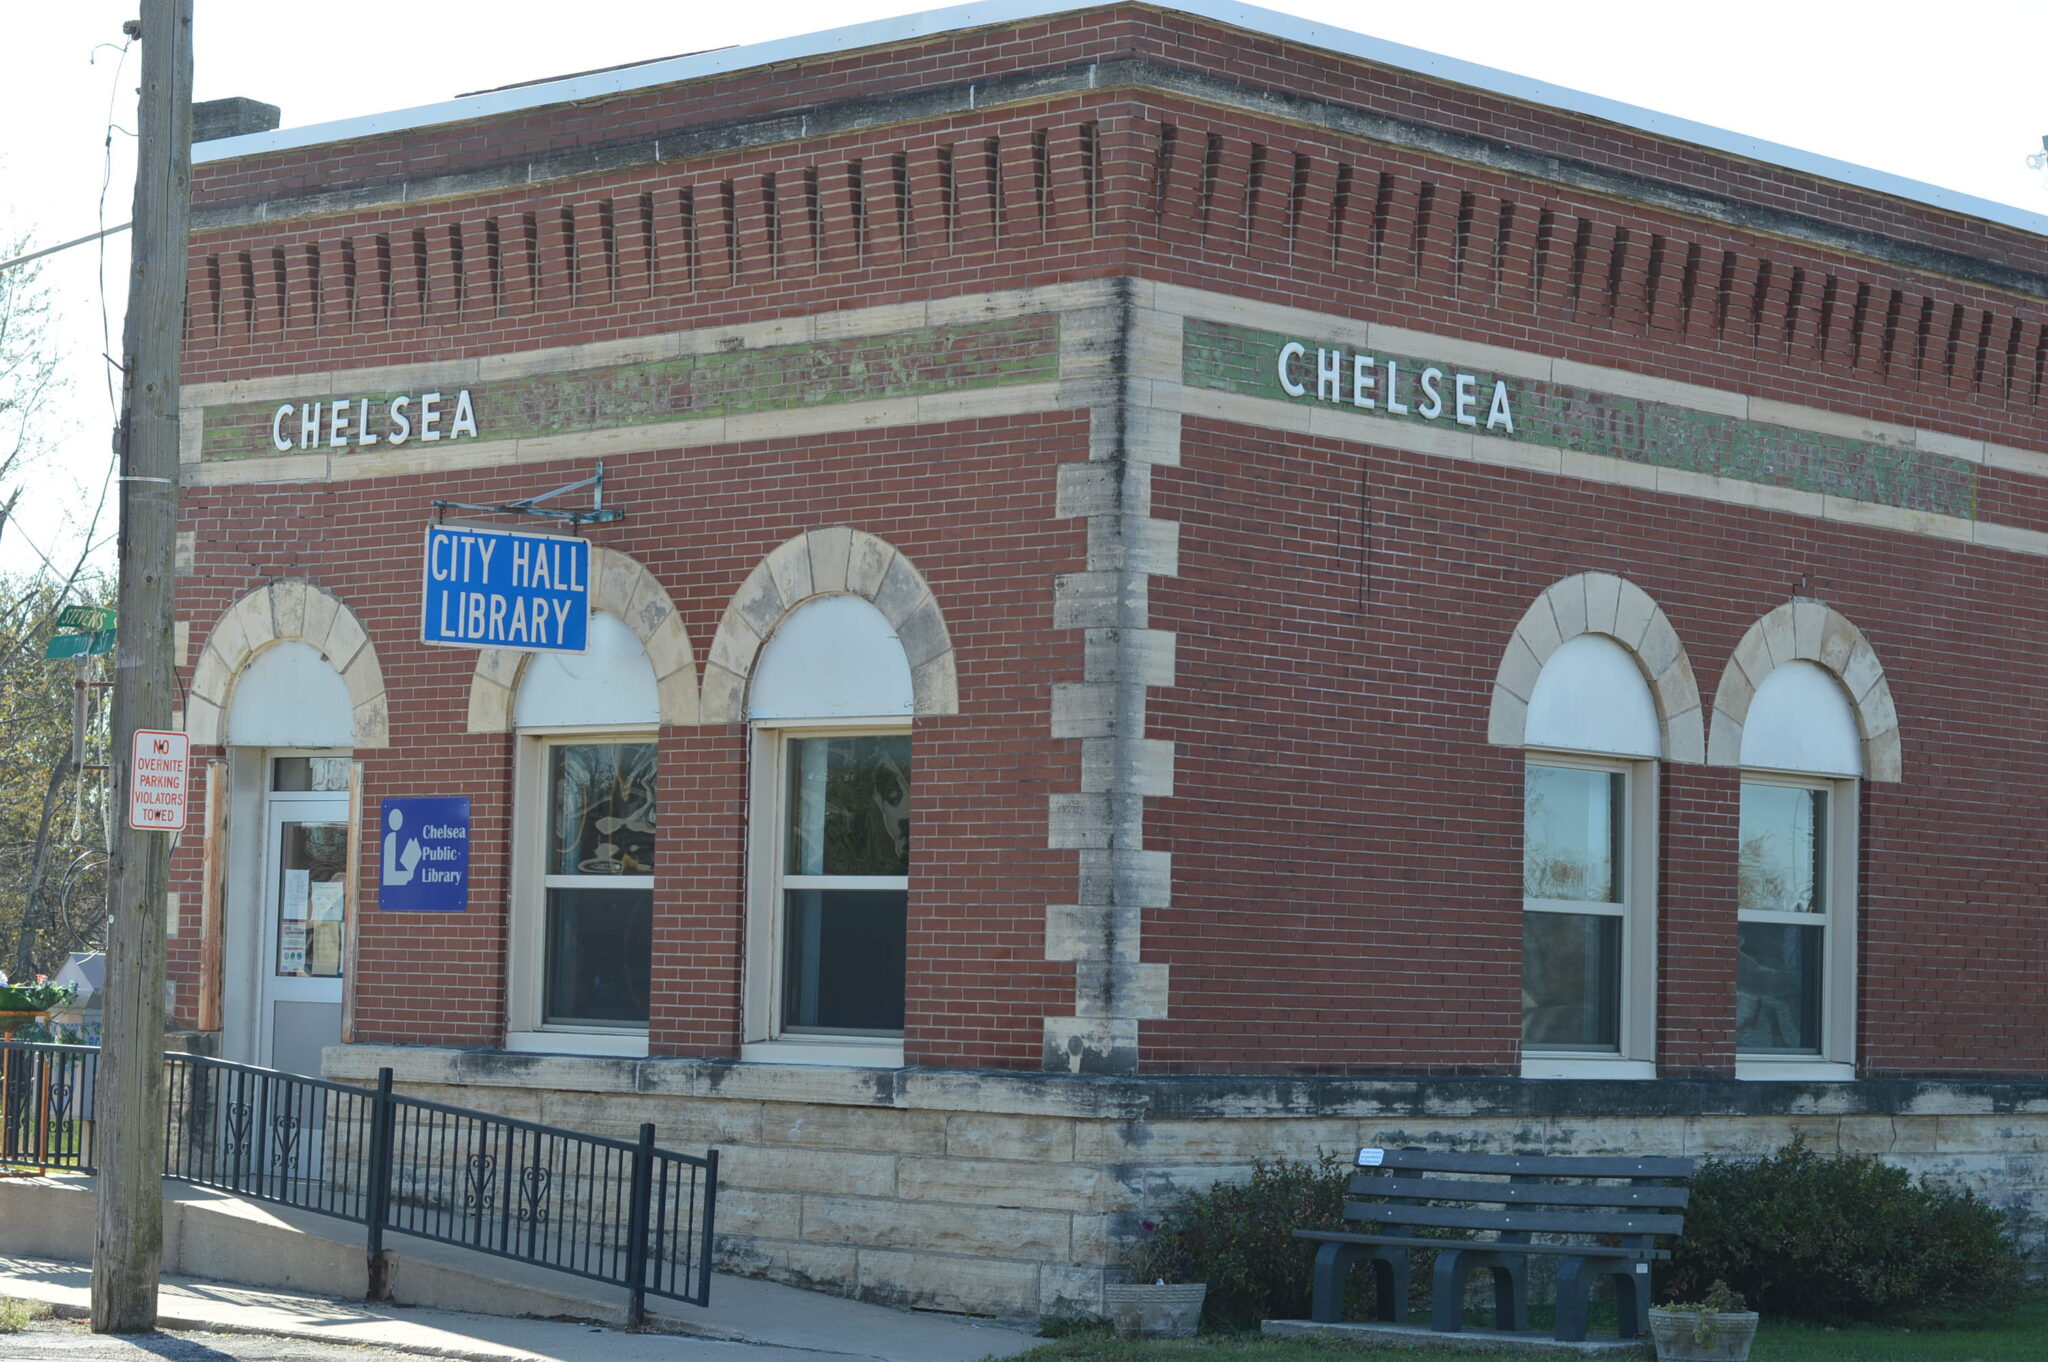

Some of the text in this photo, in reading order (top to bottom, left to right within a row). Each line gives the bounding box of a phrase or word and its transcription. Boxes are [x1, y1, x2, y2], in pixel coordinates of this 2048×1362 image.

[1278, 342, 1513, 433] CHELSEA
[273, 390, 478, 451] CHELSEA
[432, 534, 584, 592] CITY HALL
[61, 608, 107, 630] STEVENS
[440, 590, 572, 645] LIBRARY
[153, 739, 169, 754] NO
[138, 758, 183, 772] OVERNITE
[140, 774, 179, 789] PARKING
[135, 791, 183, 806] VIOLATORS
[143, 808, 174, 822] TOWED
[422, 824, 466, 839] Chelsea
[422, 846, 457, 861] Public
[421, 868, 462, 886] Library
